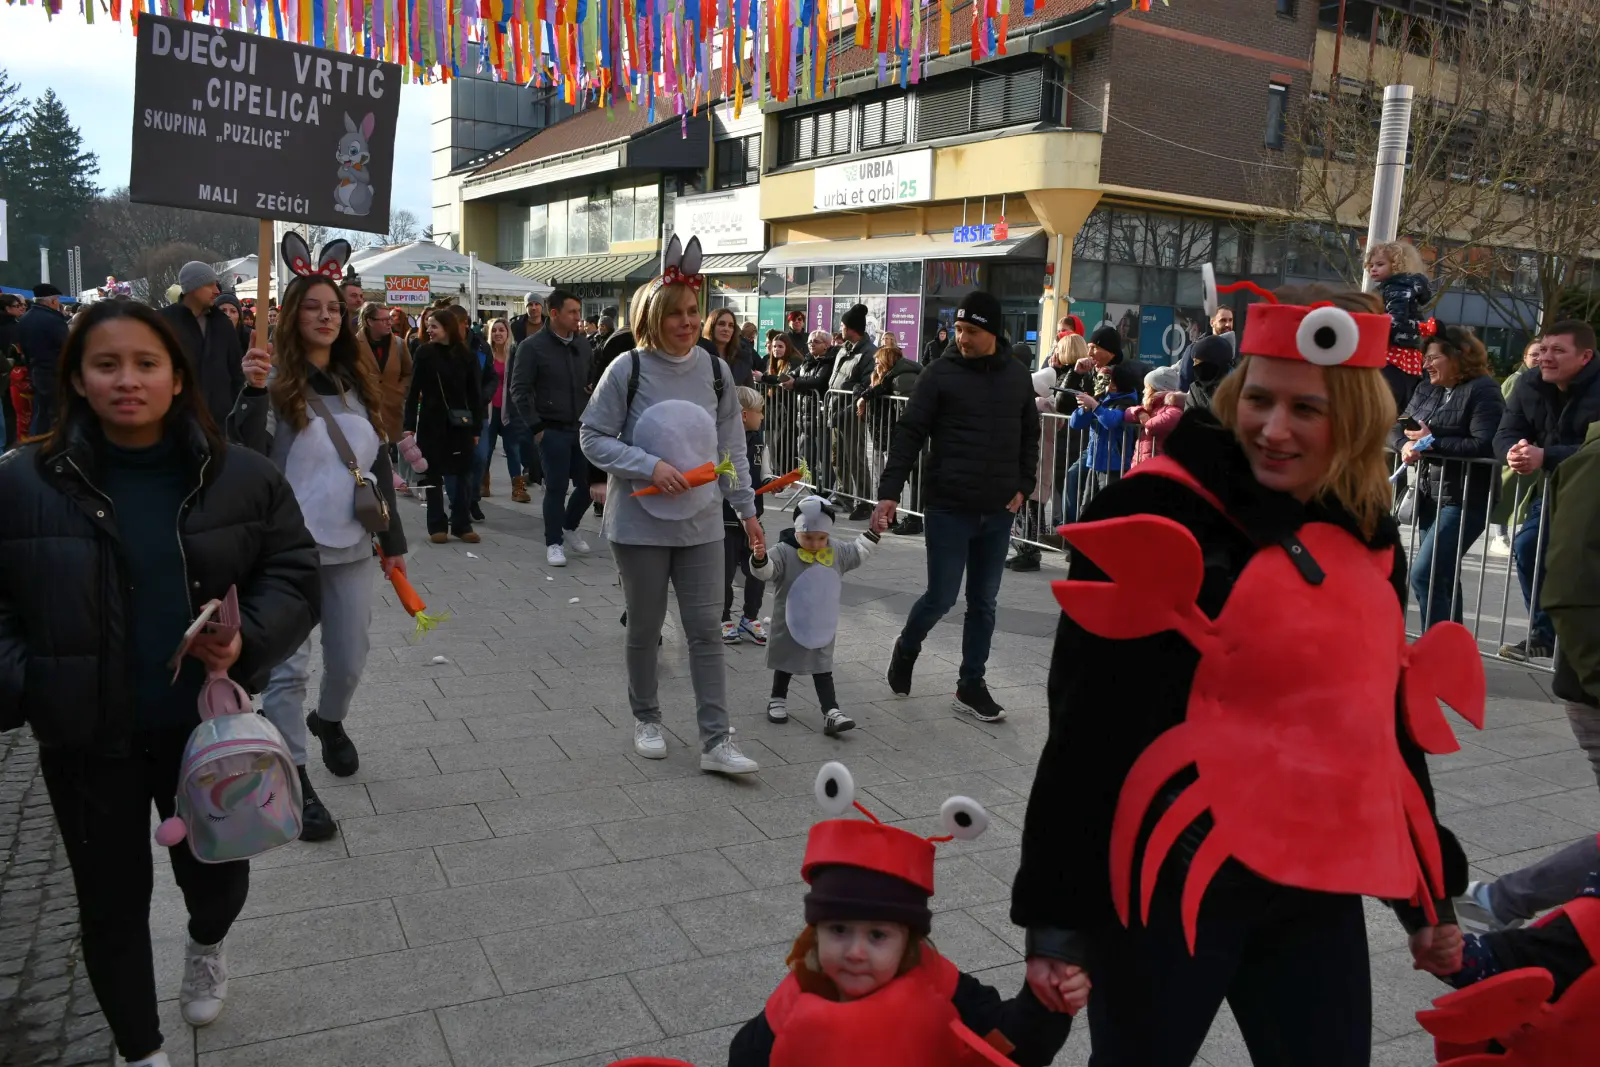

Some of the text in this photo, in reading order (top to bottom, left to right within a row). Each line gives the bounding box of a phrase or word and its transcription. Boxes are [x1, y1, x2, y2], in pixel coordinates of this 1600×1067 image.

[152, 23, 385, 98] DJEČJI VRTIĆ
[144, 108, 207, 137] SKUPINA
[859, 160, 894, 180] URBIA
[199, 184, 309, 215] MALI ZEČIĆI
[824, 179, 917, 207] urbi et orbi 25
[953, 224, 993, 243] ERSTE
[395, 277, 430, 291] CIPELICA
